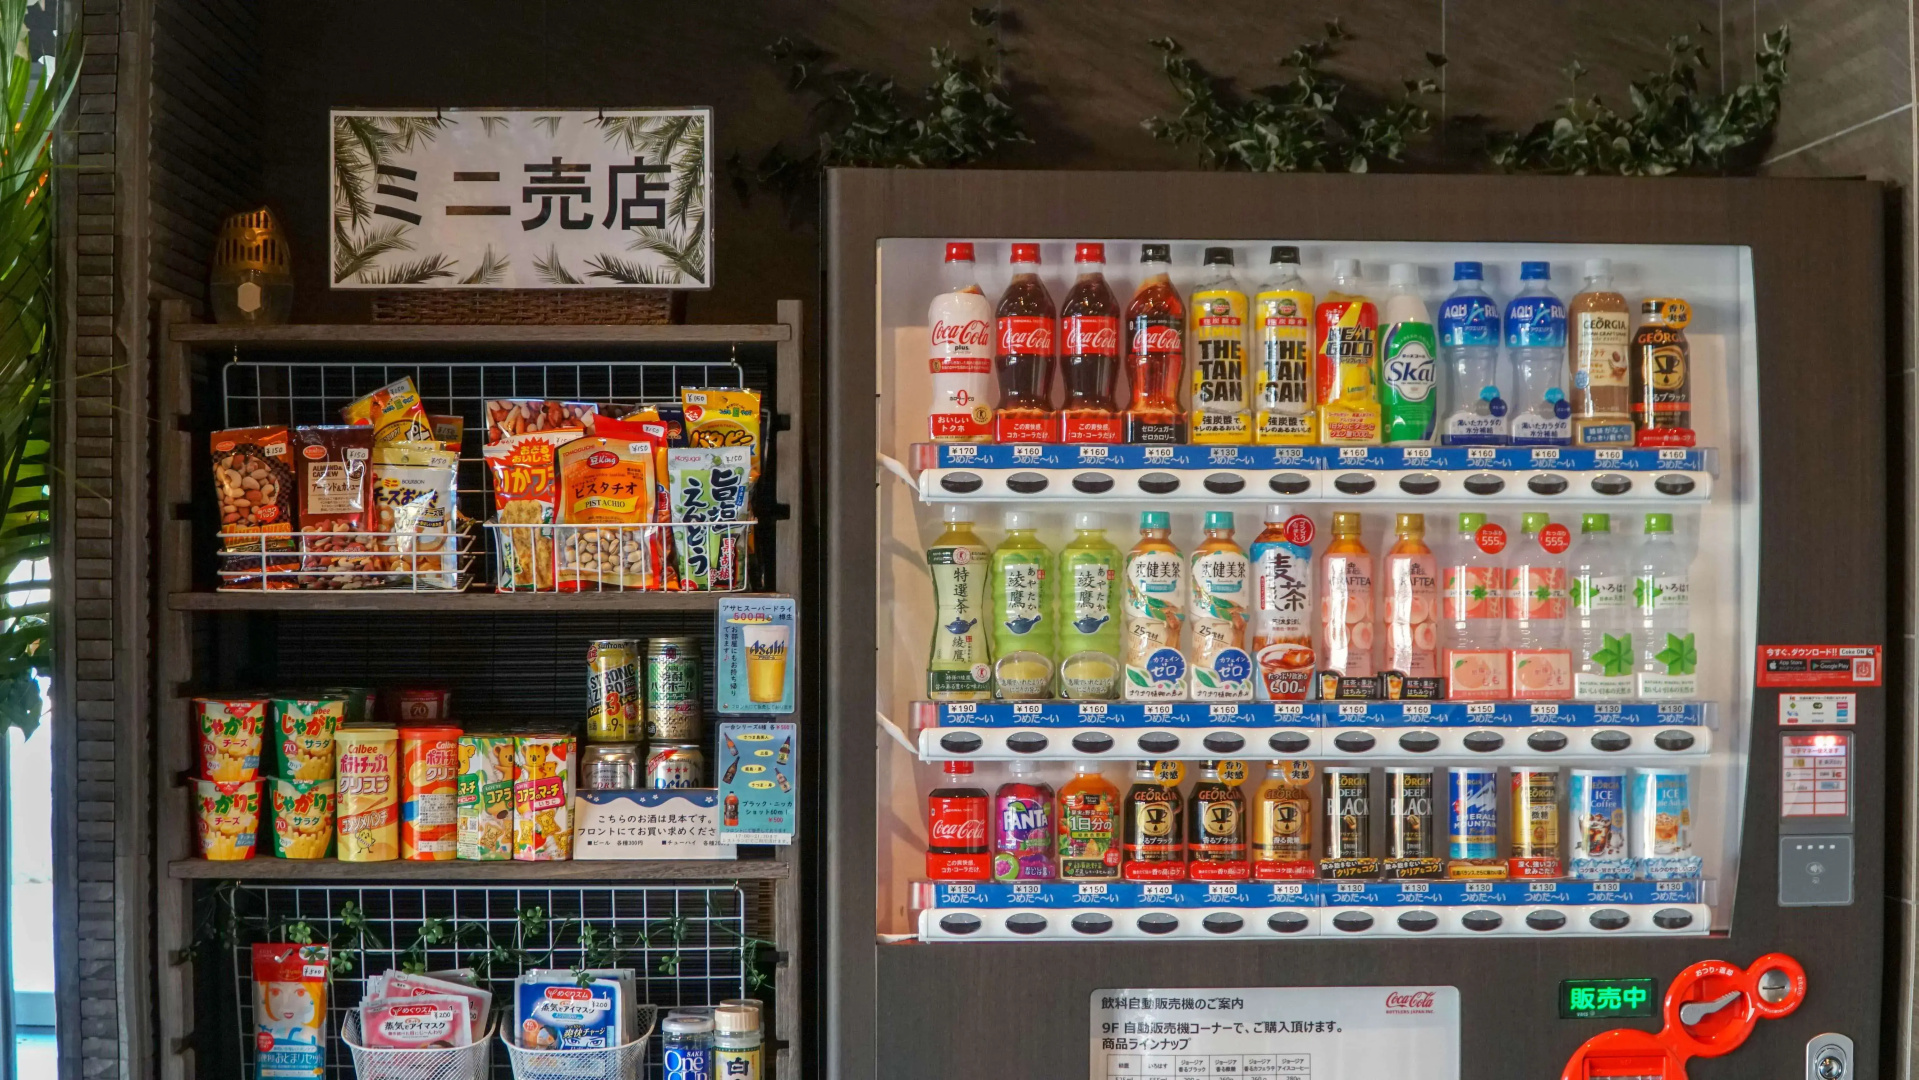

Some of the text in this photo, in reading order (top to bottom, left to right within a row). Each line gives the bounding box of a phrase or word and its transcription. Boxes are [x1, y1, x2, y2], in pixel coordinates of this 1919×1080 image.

[373, 156, 672, 231] ミニ売店
[1668, 313, 1686, 322] 実感
[932, 320, 990, 346] Coca-Cola
[1002, 327, 1051, 349] Coca-Cola
[1067, 327, 1116, 349] Coca-Cola
[1132, 328, 1182, 349] Coca-Cola
[954, 344, 969, 352] plus
[1199, 340, 1241, 360] THE
[1199, 361, 1242, 380] TAN
[1200, 381, 1242, 402] SAN
[937, 416, 969, 424] おいしい
[941, 425, 966, 433] トクホ
[952, 447, 975, 455] ¥170
[1018, 447, 1040, 455] ¥160
[1148, 449, 1171, 457] ¥160
[1213, 449, 1236, 457] ¥130
[1342, 449, 1365, 457] ¥160
[1406, 449, 1429, 457] ¥160
[1471, 450, 1493, 458] ¥160
[1535, 450, 1557, 458] ¥160
[1598, 451, 1621, 459] ¥160
[575, 482, 637, 499] ピスタチオ
[585, 500, 625, 508] PISTACHIO
[707, 468, 743, 534] 旨塩
[681, 478, 708, 576] えんどう
[1135, 562, 1181, 578] 爽健美茶
[1201, 562, 1247, 578] 爽健美茶
[1270, 553, 1307, 612] 麦茶
[953, 567, 969, 614] 特選茶
[1007, 570, 1027, 610] 綾鷹
[1027, 567, 1037, 611] あやたか
[1077, 570, 1097, 610] 綾鷹
[1097, 567, 1107, 611] あやたか
[733, 613, 765, 621] 500円
[749, 640, 785, 655] Asahi
[952, 636, 965, 663] 綾鷹
[1766, 648, 1837, 656] 今すぐ、ダウンロード!!
[730, 626, 738, 696] お部屋にもお持ち帰り
[1152, 656, 1180, 664] カフェイン
[1219, 656, 1247, 664] カフェイン
[1150, 662, 1177, 677] ゼロ
[1218, 662, 1245, 677] ゼロ
[1269, 680, 1306, 694] 600ml
[412, 706, 426, 716] 70
[1016, 705, 1039, 713] ¥160
[1082, 705, 1105, 713] ¥160
[1470, 705, 1492, 713] ¥150
[1597, 705, 1619, 713] ¥130
[1661, 705, 1683, 713] ¥130
[203, 744, 215, 752] 70
[223, 739, 248, 747] チーズ
[284, 744, 296, 752] 70
[305, 739, 331, 748] サラダ
[348, 744, 378, 754] Calbee
[340, 754, 388, 773] ポテトチップス
[1224, 761, 1242, 769] 香り
[1159, 771, 1178, 780] 実感
[1224, 771, 1243, 779] 実感
[1291, 771, 1309, 779] 実感
[340, 776, 390, 794] クリスプ
[487, 788, 512, 803] コアラ
[517, 783, 559, 803] コアラのマーチ
[1595, 790, 1613, 800] ICE
[1662, 789, 1679, 798] ICE
[1591, 800, 1617, 808] Coffee
[598, 814, 712, 824] こちらのお酒は見本です。
[1003, 809, 1048, 831] FANTA
[1531, 810, 1549, 820] 微糖
[214, 816, 240, 825] チーズ
[276, 821, 286, 829] 70
[293, 816, 321, 826] サラダ
[1070, 817, 1112, 831] 1日分の
[578, 827, 716, 836] フロントにてお買い求めくださ
[933, 819, 985, 839] Coca-Cola
[1532, 883, 1554, 891] ¥130
[1385, 990, 1436, 1010] Coca-Cola
[1570, 986, 1647, 1011] 販売中
[1100, 997, 1245, 1011] 飲料自動販売機のご案内
[385, 1021, 446, 1031] 蒸気でアイマスク
[1102, 1020, 1344, 1035] 9F 自動販売機コーナーで、ご購入頂けます。
[563, 1027, 606, 1039] 爽快チャージ
[1102, 1037, 1191, 1051] 商品ラインナップ
[665, 1050, 704, 1072] One
[727, 1057, 749, 1076] 白
